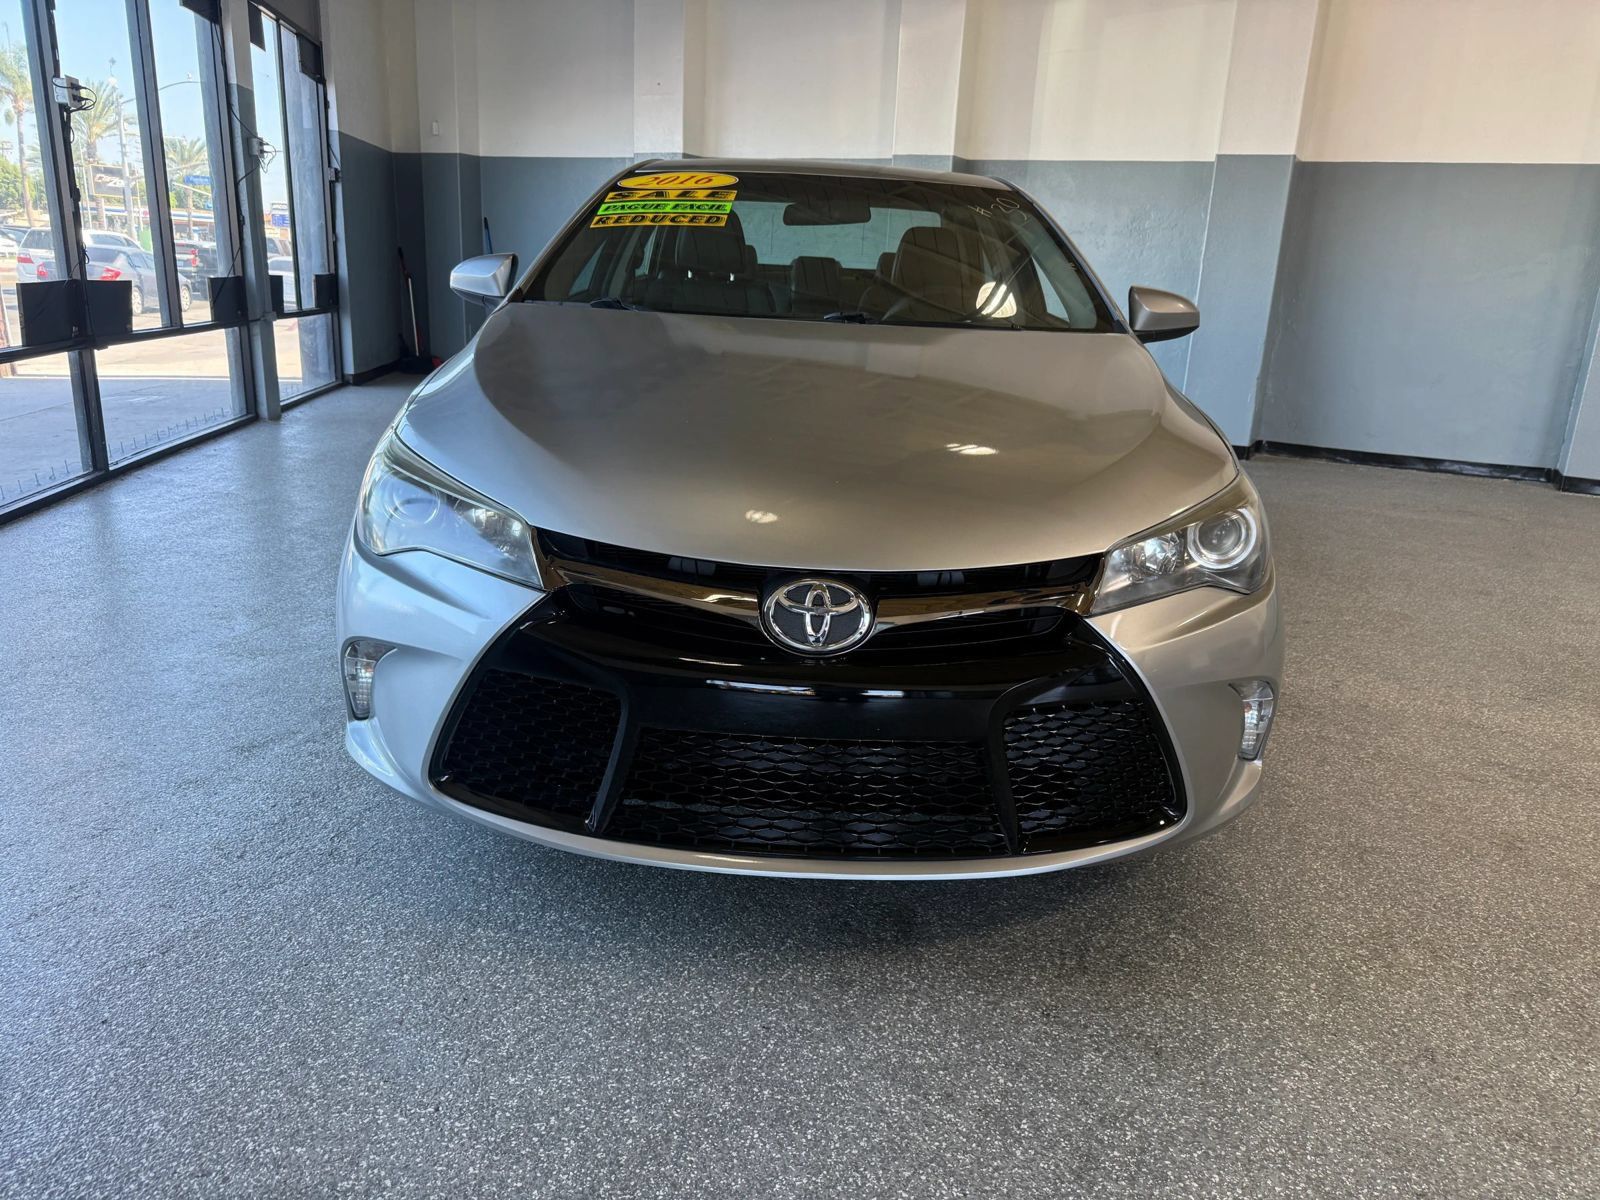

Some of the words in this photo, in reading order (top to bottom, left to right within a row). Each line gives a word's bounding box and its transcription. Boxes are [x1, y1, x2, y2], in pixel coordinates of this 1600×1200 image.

[635, 175, 716, 186] 2016
[608, 190, 732, 200] SALE
[671, 202, 728, 211] FACIL
[594, 214, 723, 225] REDUCED
